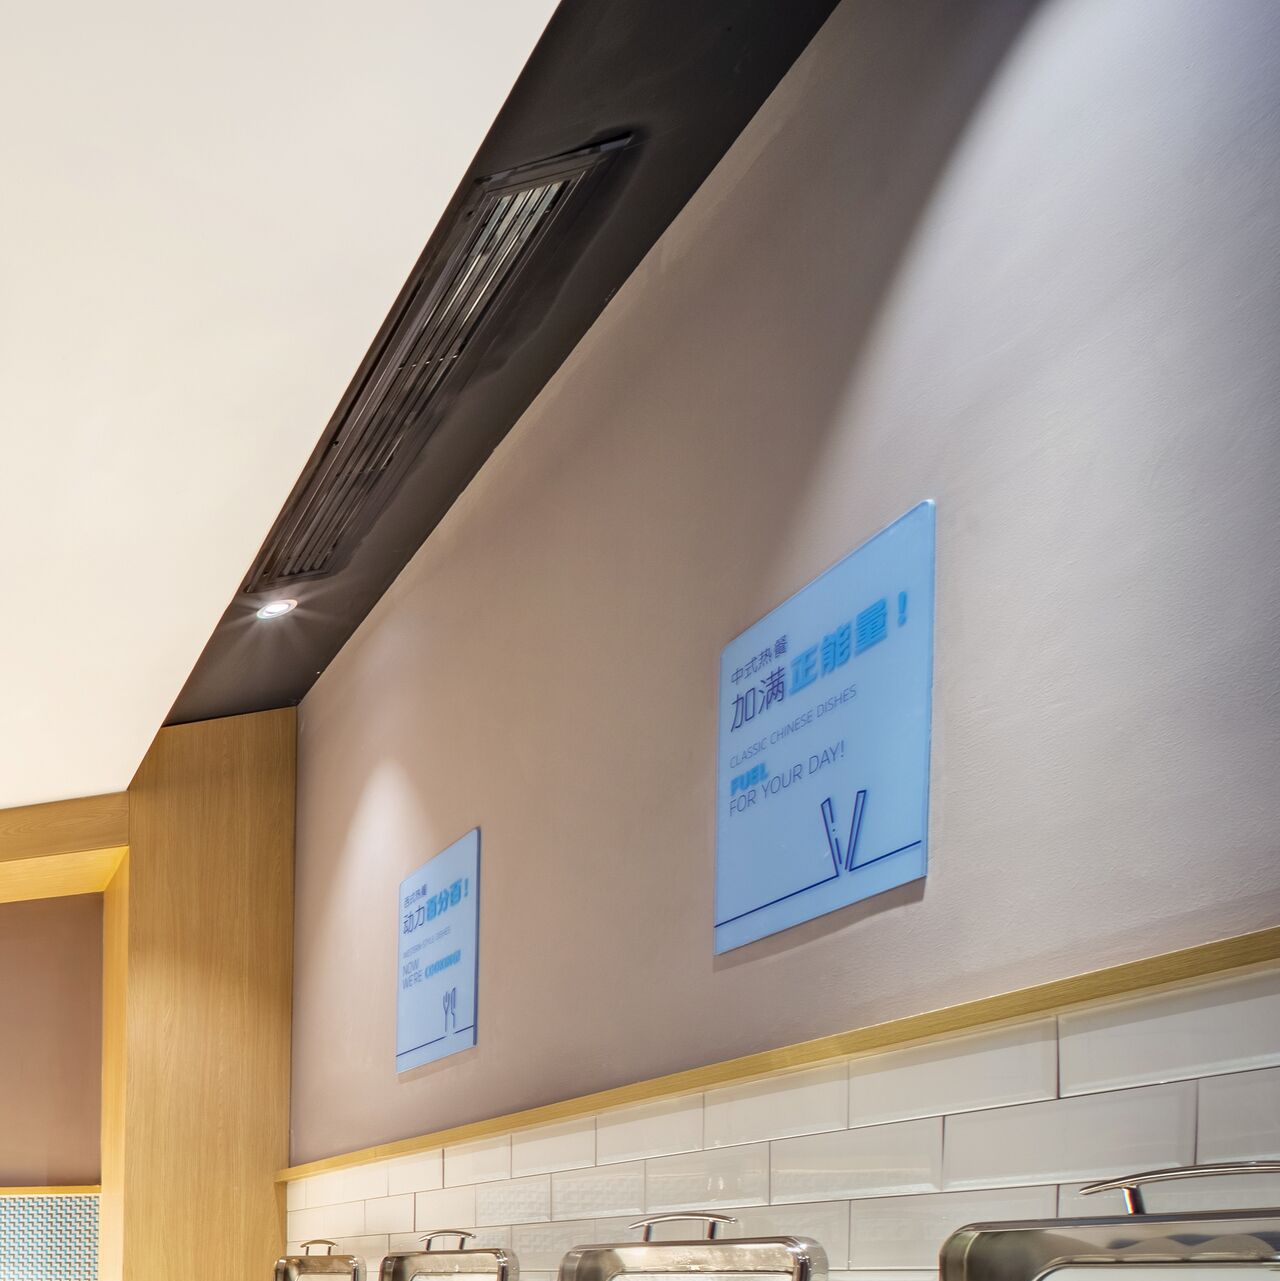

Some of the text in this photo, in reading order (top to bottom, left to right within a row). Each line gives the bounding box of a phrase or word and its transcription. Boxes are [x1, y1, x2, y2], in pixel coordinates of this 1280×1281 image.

[730, 590, 908, 733] 加满正能量！
[731, 634, 789, 685] 中式热餐
[729, 683, 857, 769] CLASSIC CHINESE DISHES
[729, 740, 845, 817] FOR YOUR DAY!
[730, 762, 769, 796] FUEL
